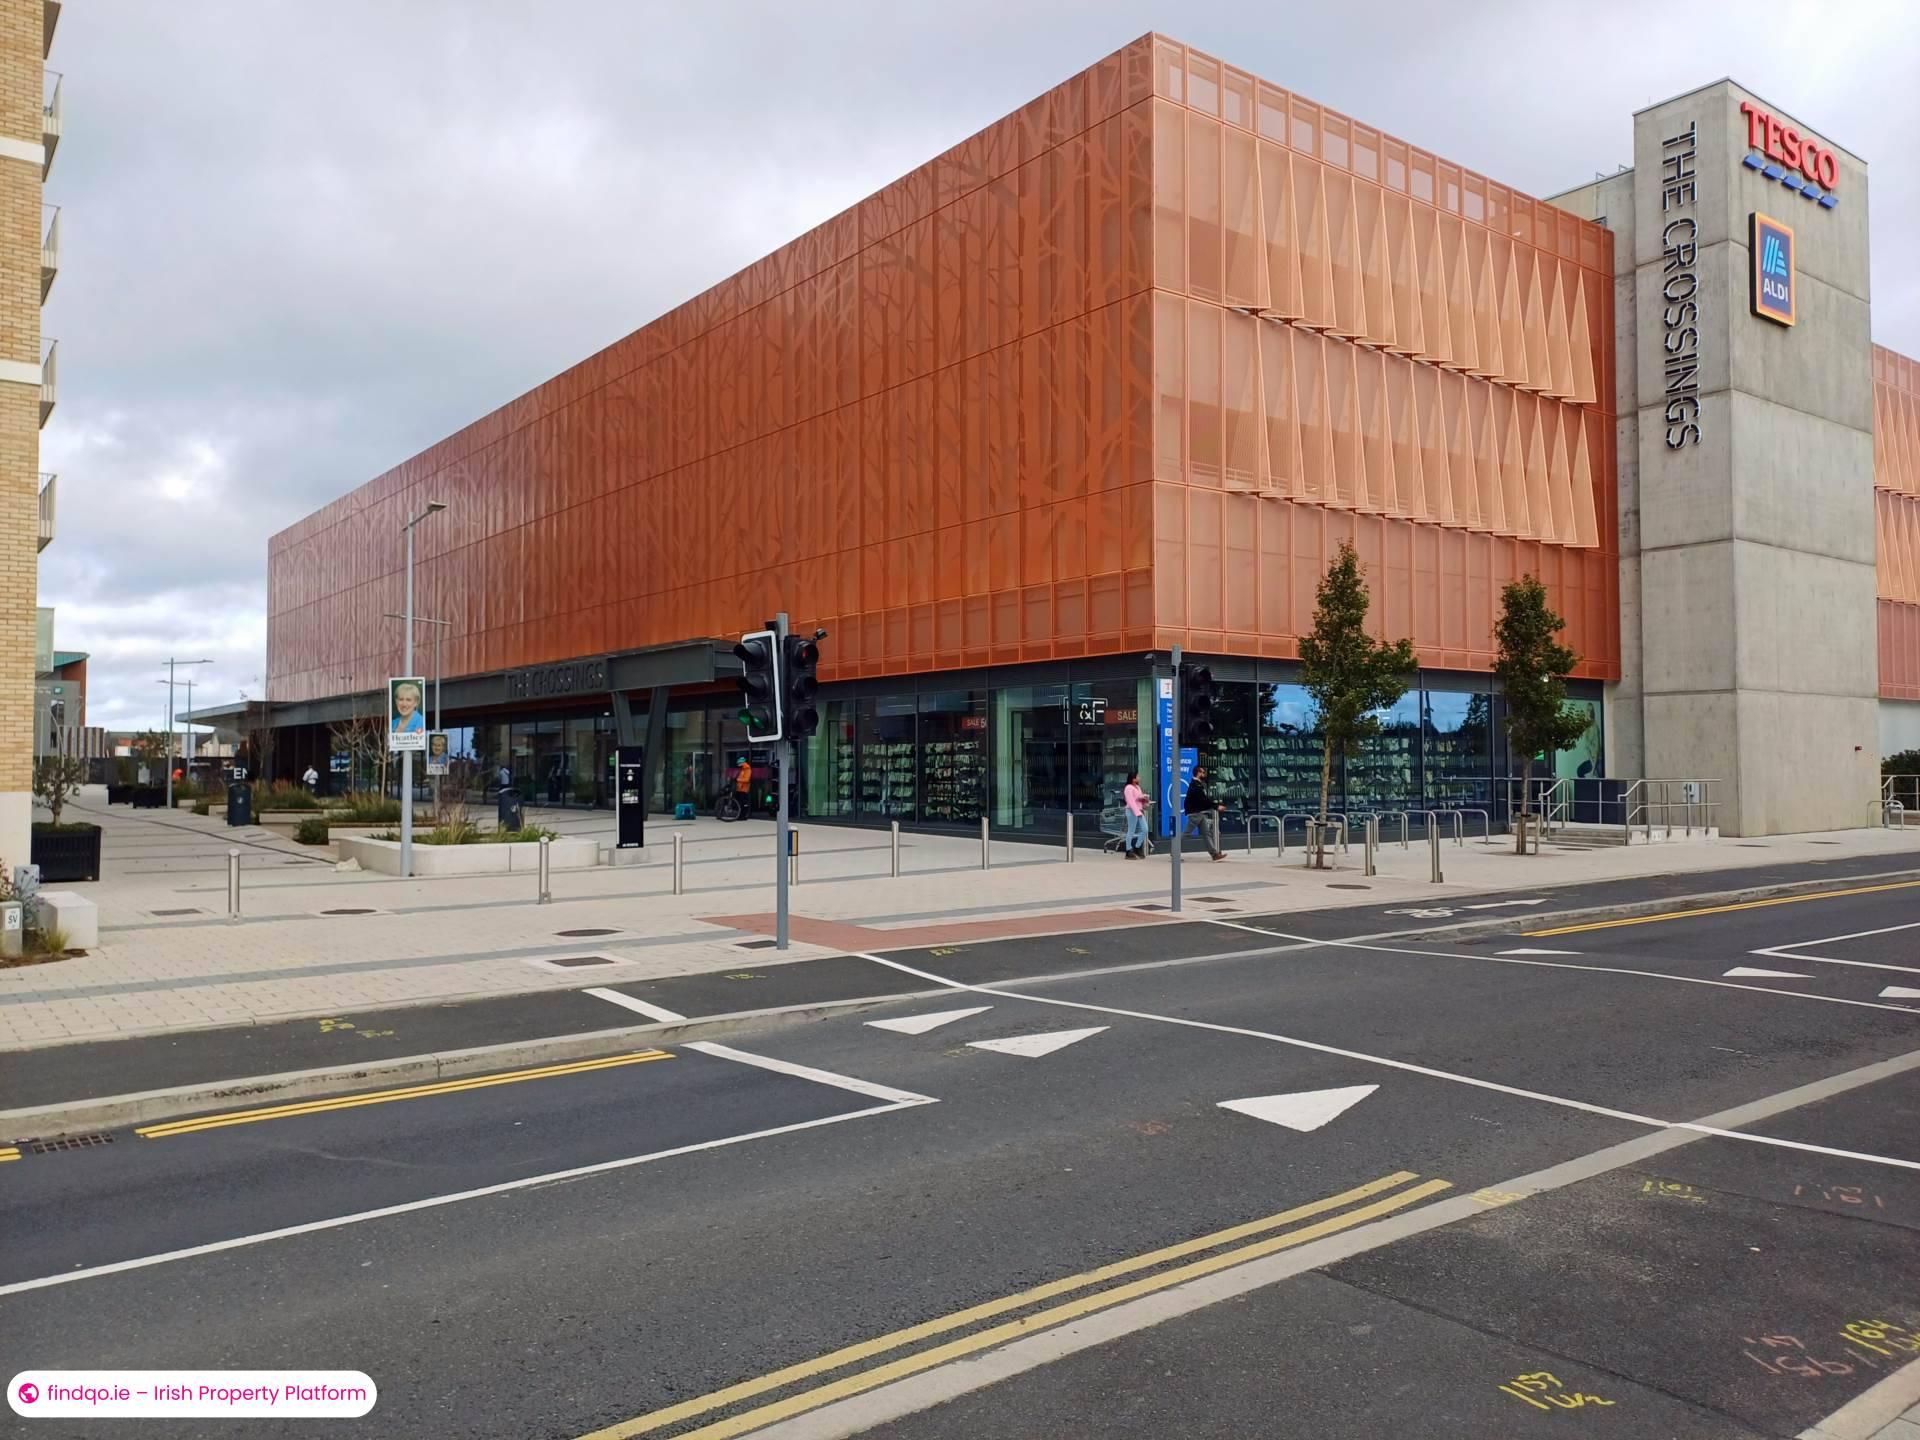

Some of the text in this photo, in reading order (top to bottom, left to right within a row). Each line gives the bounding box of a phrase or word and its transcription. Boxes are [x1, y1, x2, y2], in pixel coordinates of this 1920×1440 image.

[1740, 102, 1839, 191] TESCO
[1662, 120, 1702, 450] THE CROSSINGS
[1763, 278, 1788, 302] ALDI
[508, 662, 604, 698] THE CROSSINGS
[1117, 710, 1137, 721] SALE
[8, 914, 18, 925] SV
